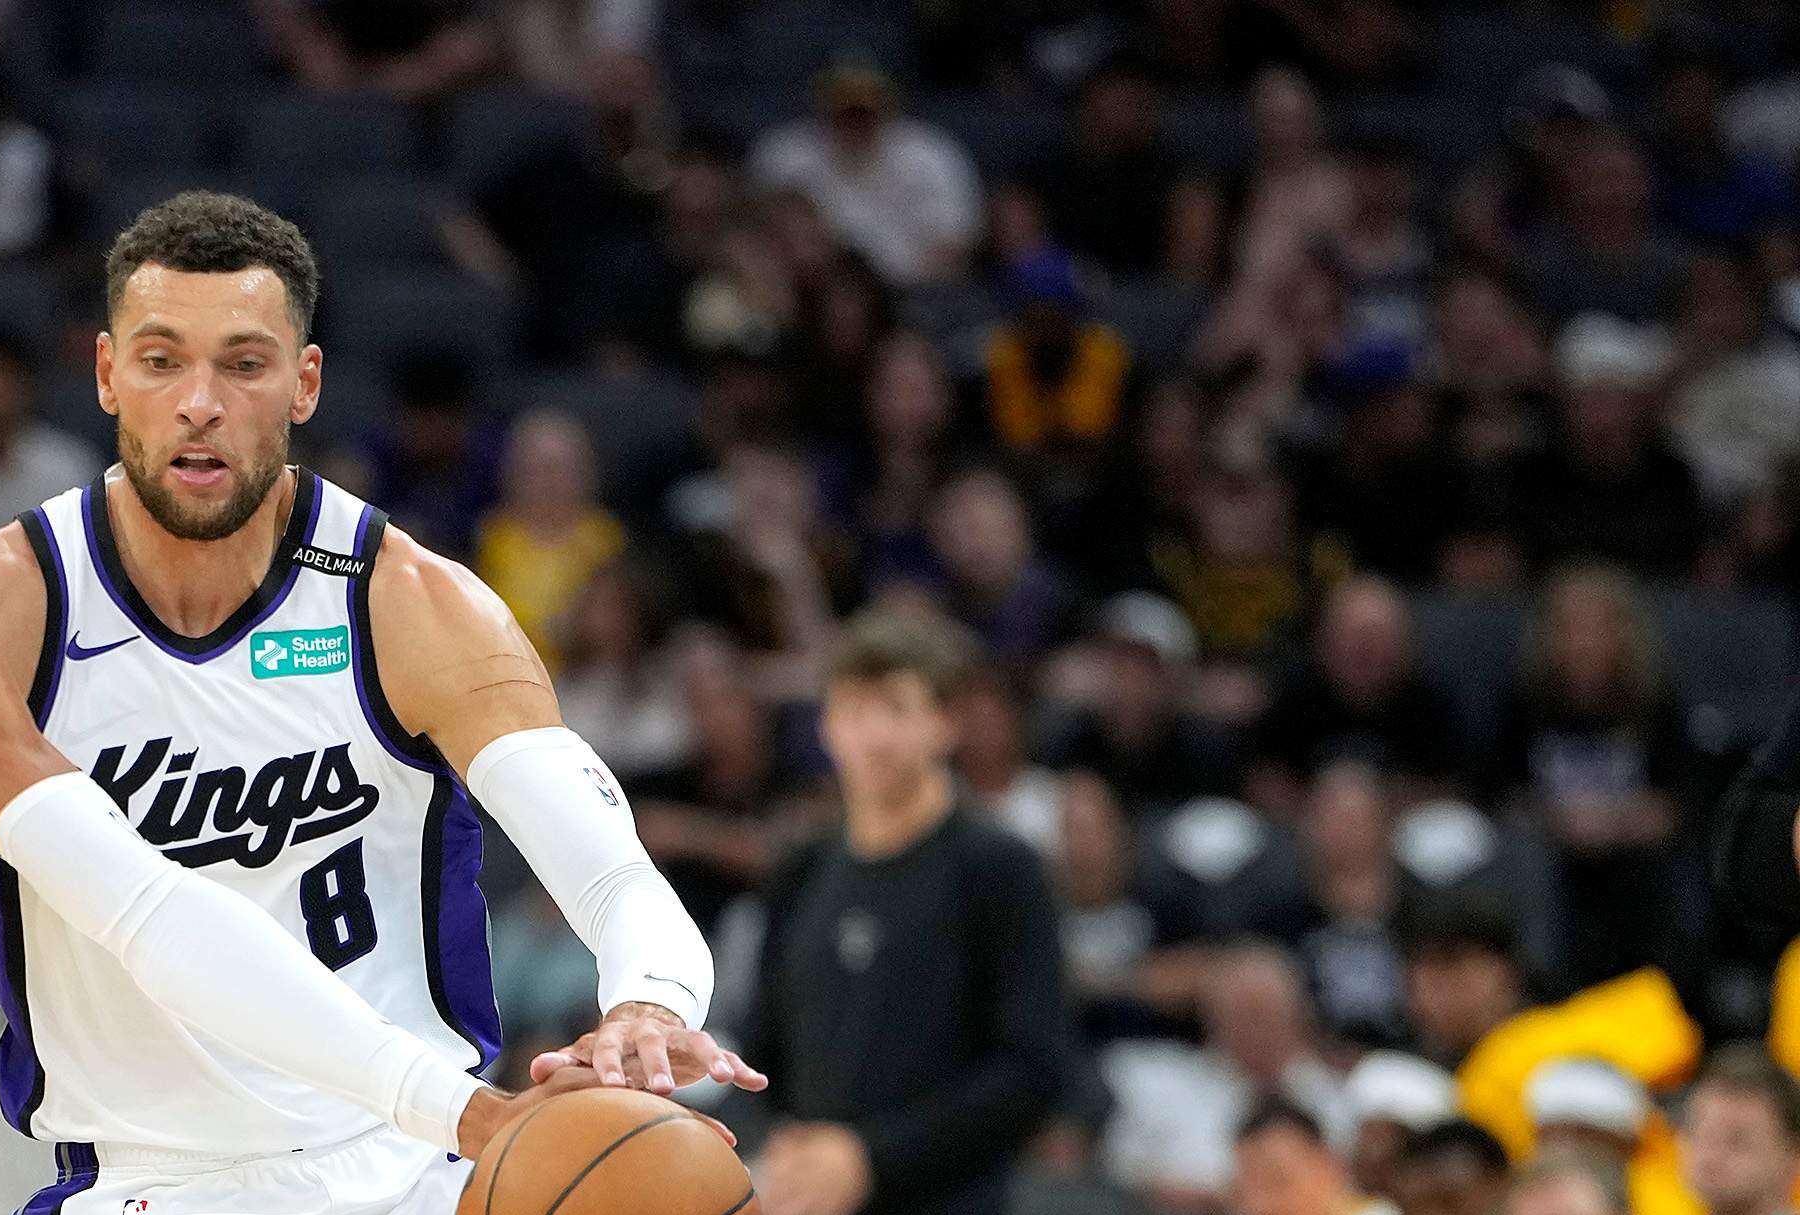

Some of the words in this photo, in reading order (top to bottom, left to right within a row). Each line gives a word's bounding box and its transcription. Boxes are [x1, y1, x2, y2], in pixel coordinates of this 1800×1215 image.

[292, 547, 364, 574] ADELMAN
[291, 636, 344, 652] Sutter
[293, 650, 347, 669] Health
[89, 735, 380, 869] Kings
[299, 836, 378, 972] 8
